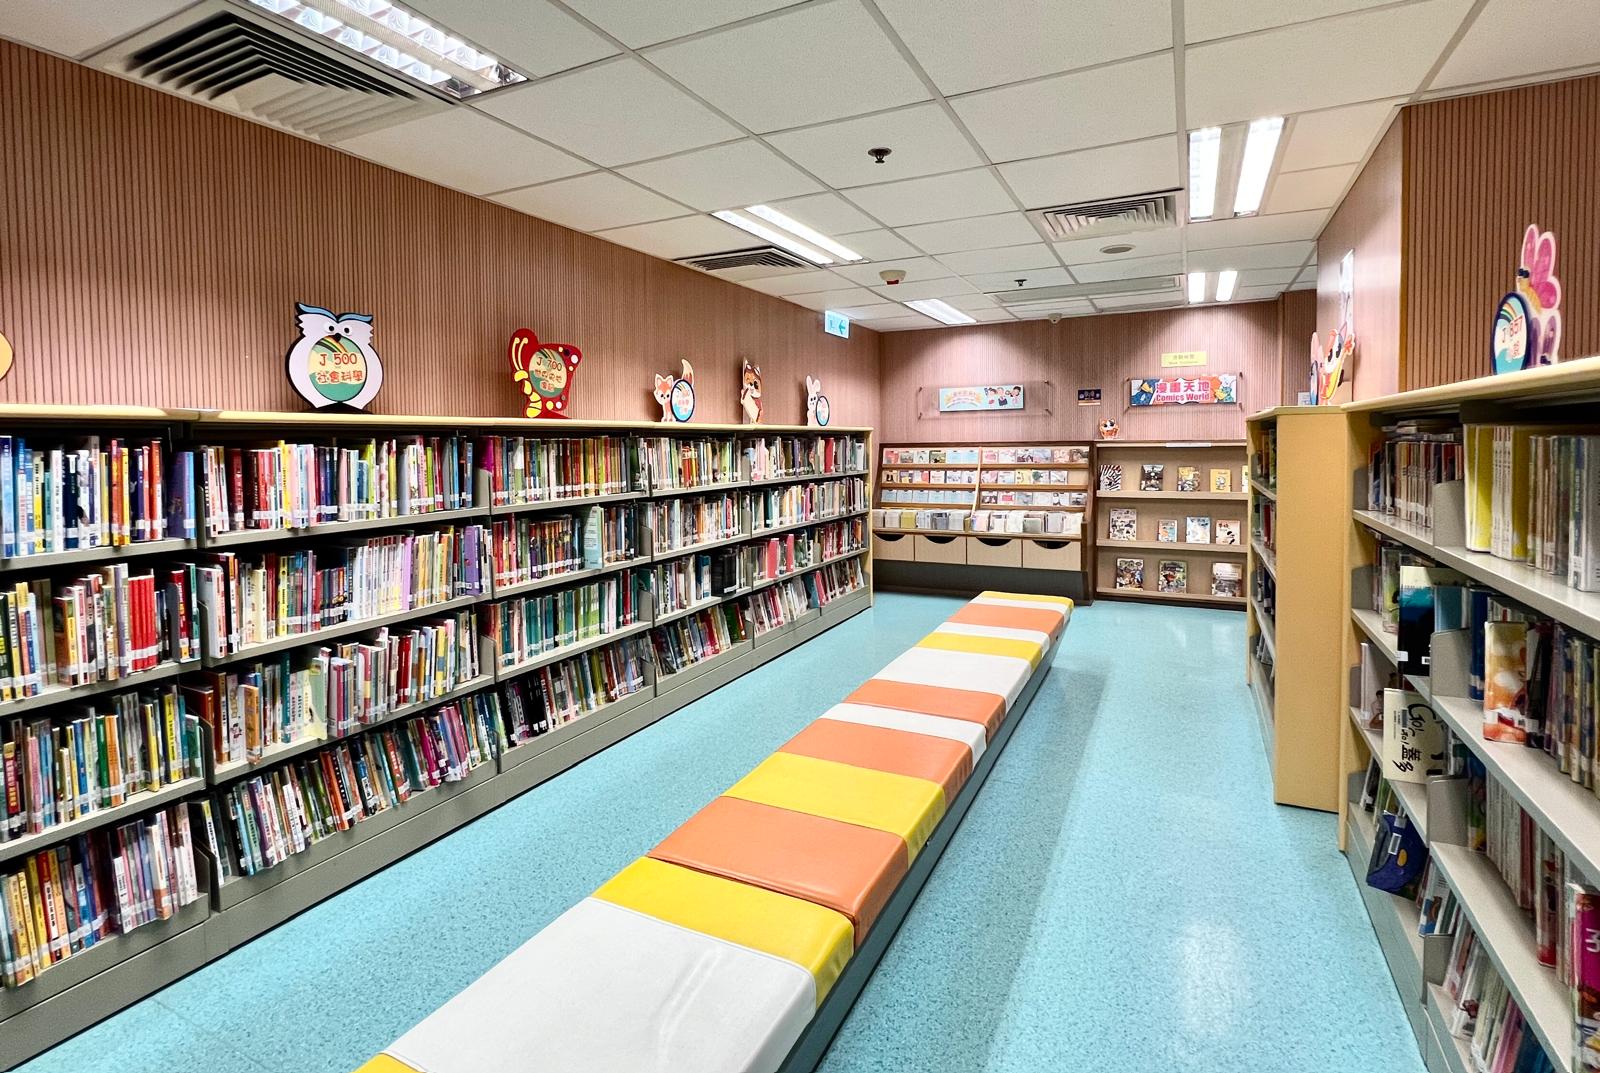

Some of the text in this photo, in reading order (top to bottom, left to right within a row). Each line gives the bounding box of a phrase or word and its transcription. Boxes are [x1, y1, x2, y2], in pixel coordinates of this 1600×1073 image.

[319, 353, 357, 366] J 500
[536, 356, 562, 371] J 700
[316, 370, 363, 383] 社會科學
[1156, 381, 1210, 393] 漫畫天地
[1185, 393, 1209, 401] World
